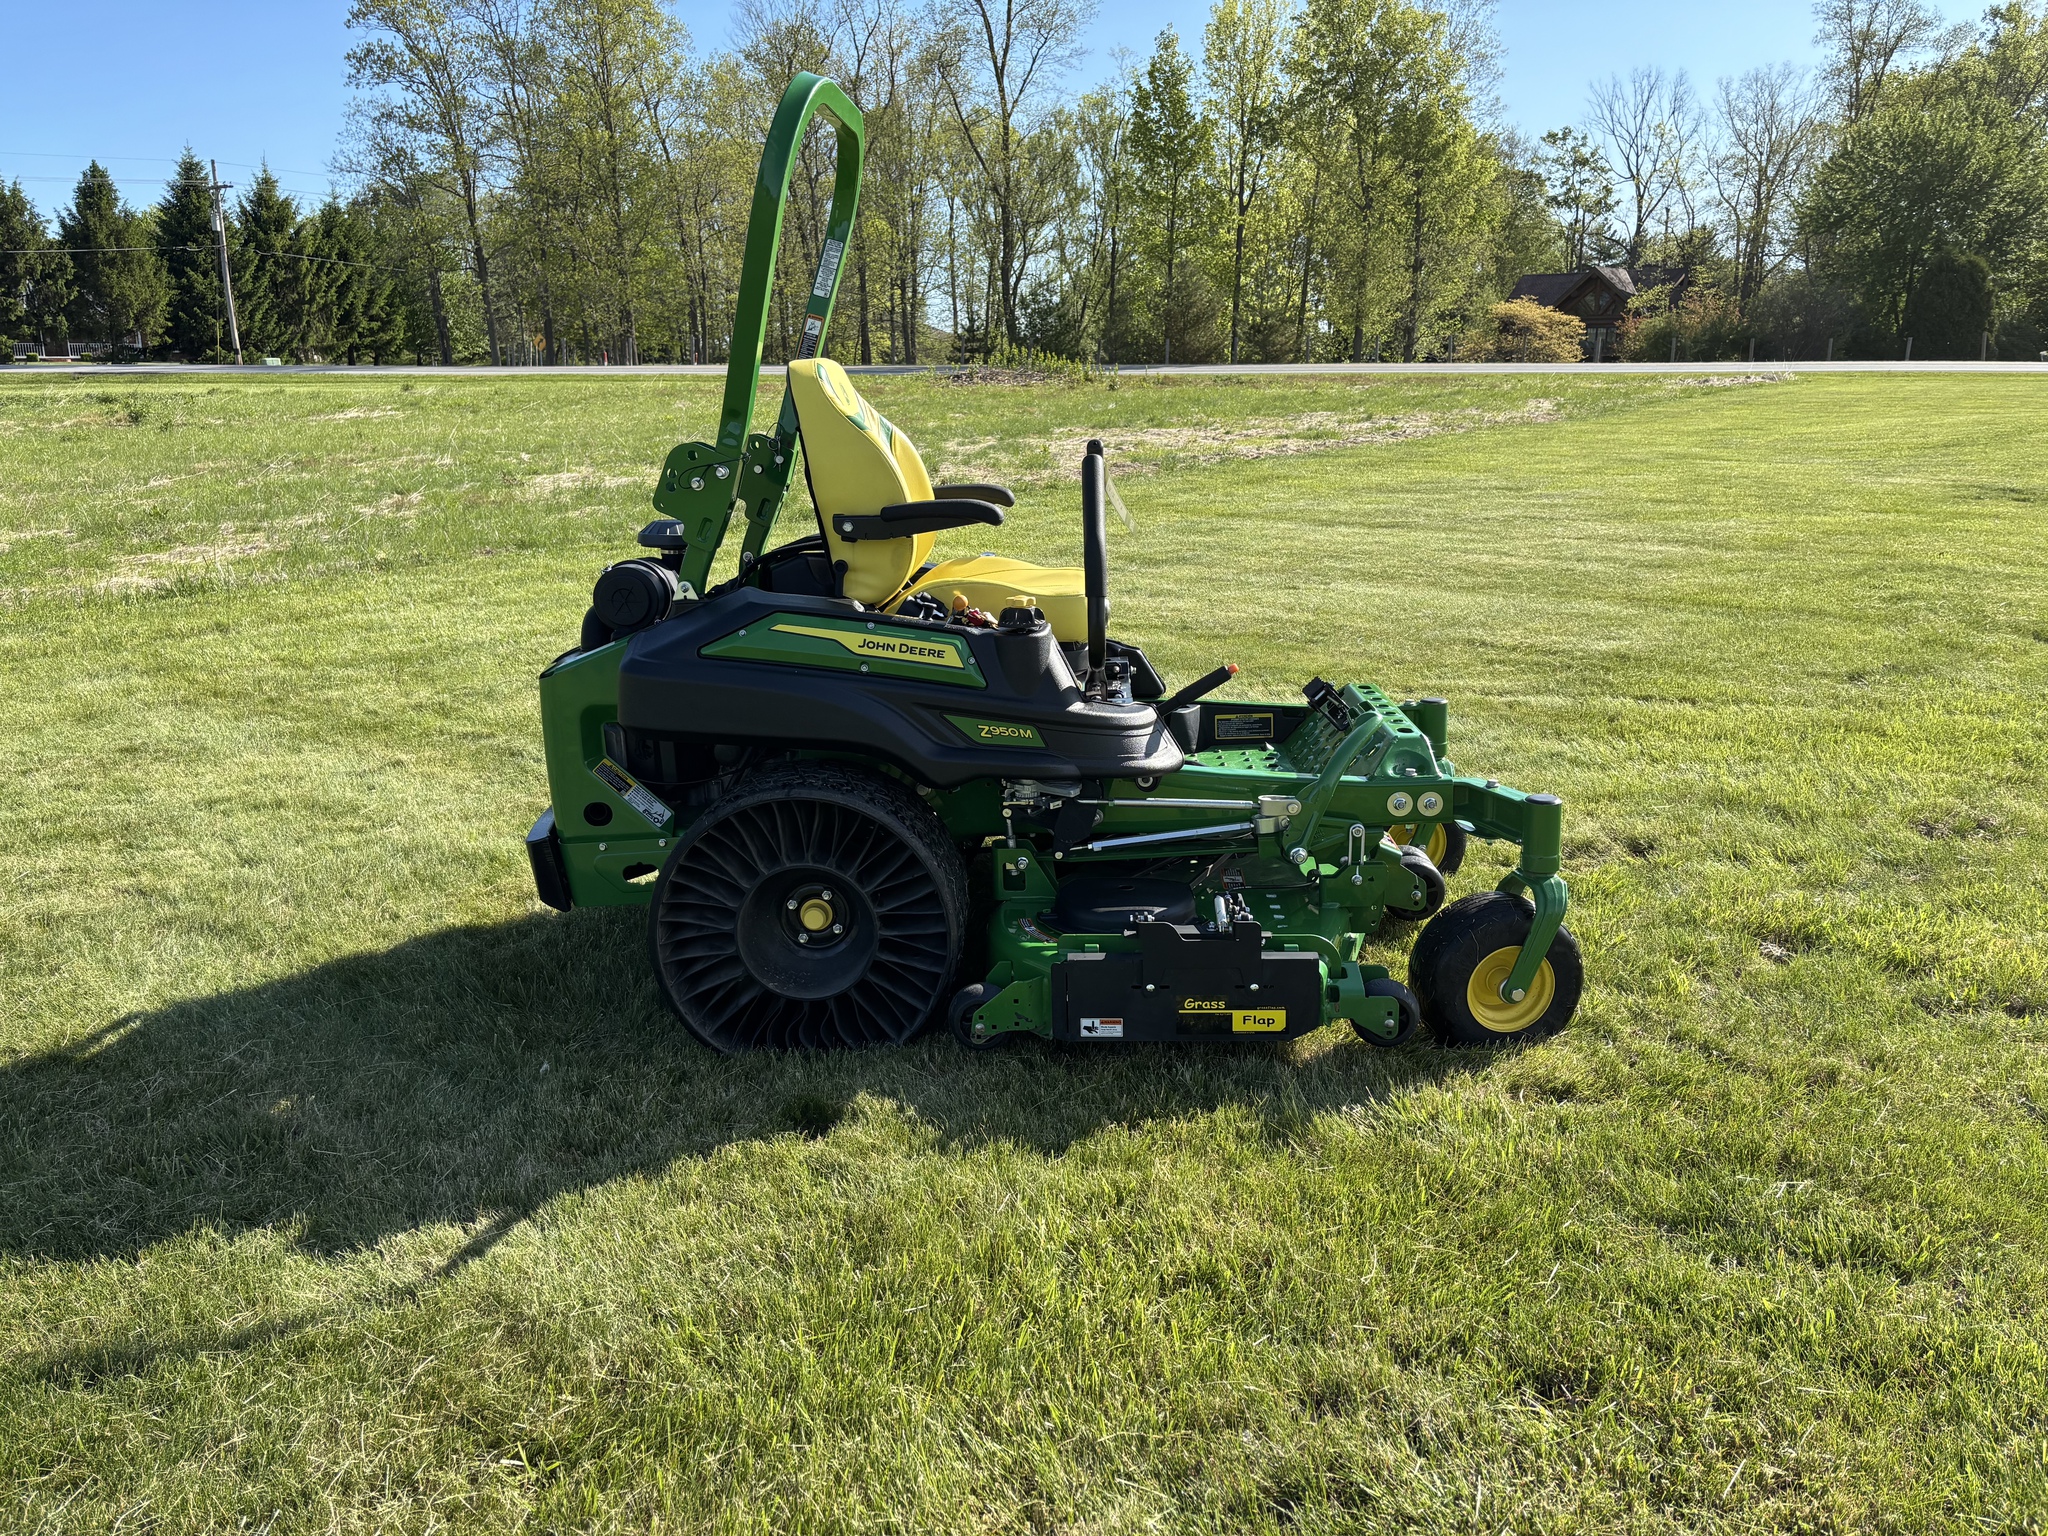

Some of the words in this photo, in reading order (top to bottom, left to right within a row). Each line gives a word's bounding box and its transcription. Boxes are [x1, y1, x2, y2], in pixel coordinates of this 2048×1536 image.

[858, 638, 896, 652] JOHN
[898, 643, 946, 658] DEERE
[977, 725, 1033, 739] Z950M
[1184, 998, 1226, 1009] Grass
[1242, 1015, 1276, 1027] Flap
